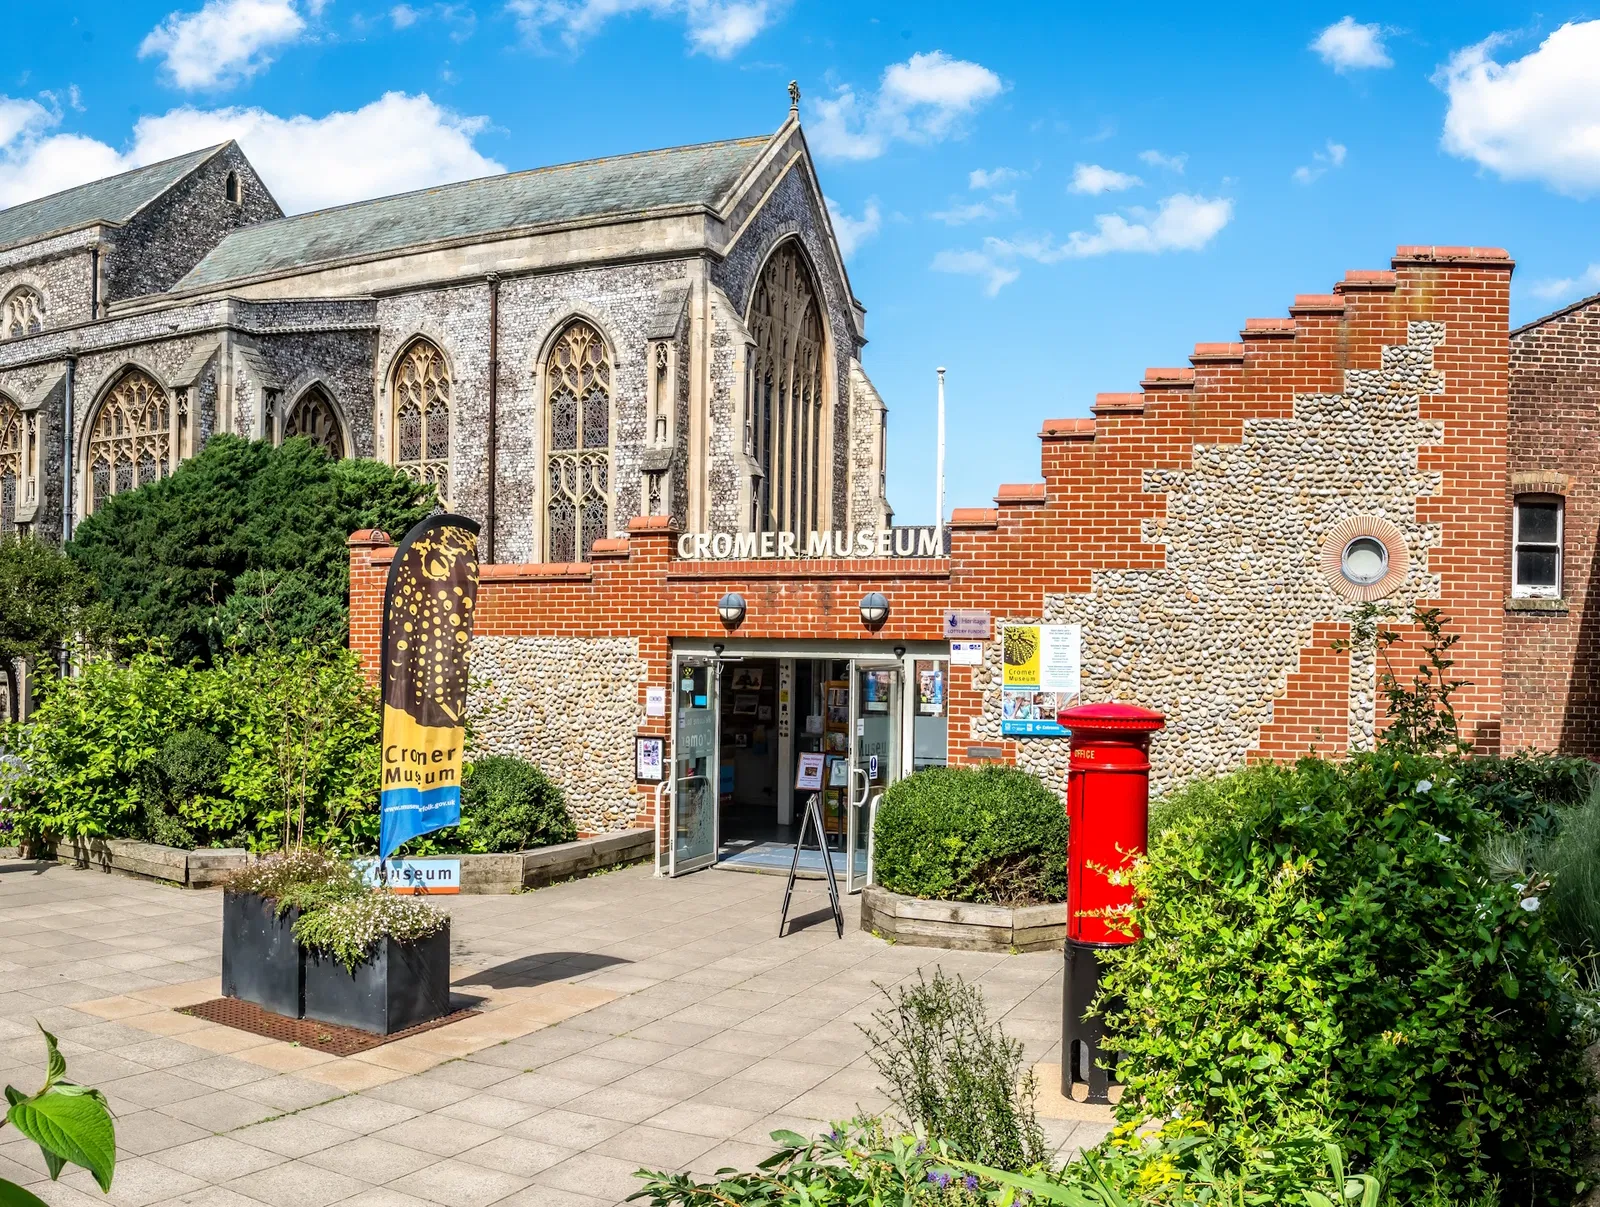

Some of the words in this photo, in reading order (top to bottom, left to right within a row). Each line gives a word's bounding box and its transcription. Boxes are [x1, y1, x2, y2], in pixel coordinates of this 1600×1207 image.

[677, 530, 797, 559] CROMER
[807, 528, 944, 558] MUSEUM
[961, 617, 986, 627] Heritage
[1008, 668, 1036, 676] Cromer
[1074, 749, 1095, 759] OFFICE
[385, 767, 455, 785] Musum
